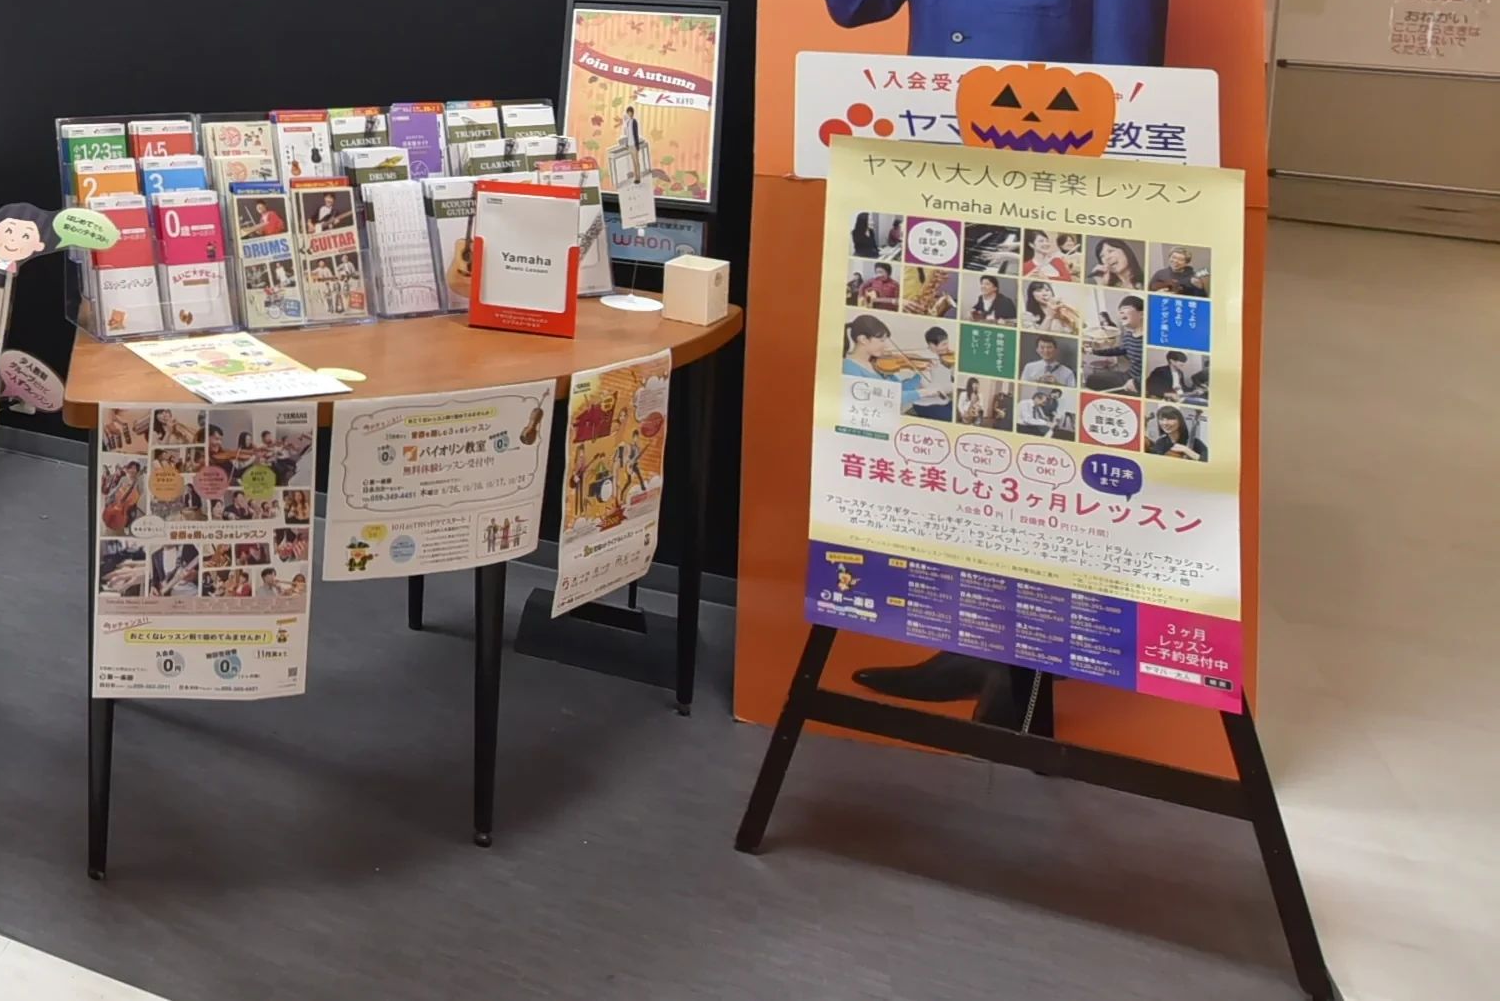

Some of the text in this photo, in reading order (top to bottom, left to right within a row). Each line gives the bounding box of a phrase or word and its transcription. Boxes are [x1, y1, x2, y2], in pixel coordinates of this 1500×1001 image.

[612, 65, 631, 76] us
[633, 67, 696, 91] Autumn
[883, 70, 964, 92] 入会受
[340, 136, 382, 147] CLARINET
[455, 129, 492, 139] TRUMPET
[480, 159, 521, 170] CLARINET
[368, 171, 397, 181] DRUMS
[863, 152, 1202, 205] ヤマハ大人の音楽レッスン
[921, 193, 1133, 230] Yamaha Music Lesson
[243, 239, 290, 259] DRUMS
[311, 232, 355, 252] GUITAR
[501, 251, 552, 267] Yamaha
[1094, 415, 1126, 427] 音楽を
[899, 432, 945, 448] はじめて
[1089, 425, 1130, 439] 楽しもう
[419, 439, 487, 458] バイオリン教室
[913, 444, 932, 456] OK!
[959, 441, 1008, 459] てぶらで
[972, 454, 992, 466] OK!
[1022, 452, 1071, 470] おためし
[1035, 465, 1056, 477] OK!
[1090, 459, 1135, 481] 11月末
[1100, 475, 1120, 487] まで
[1159, 634, 1213, 655] レッスン
[1144, 645, 1229, 671] ご予約受付中
